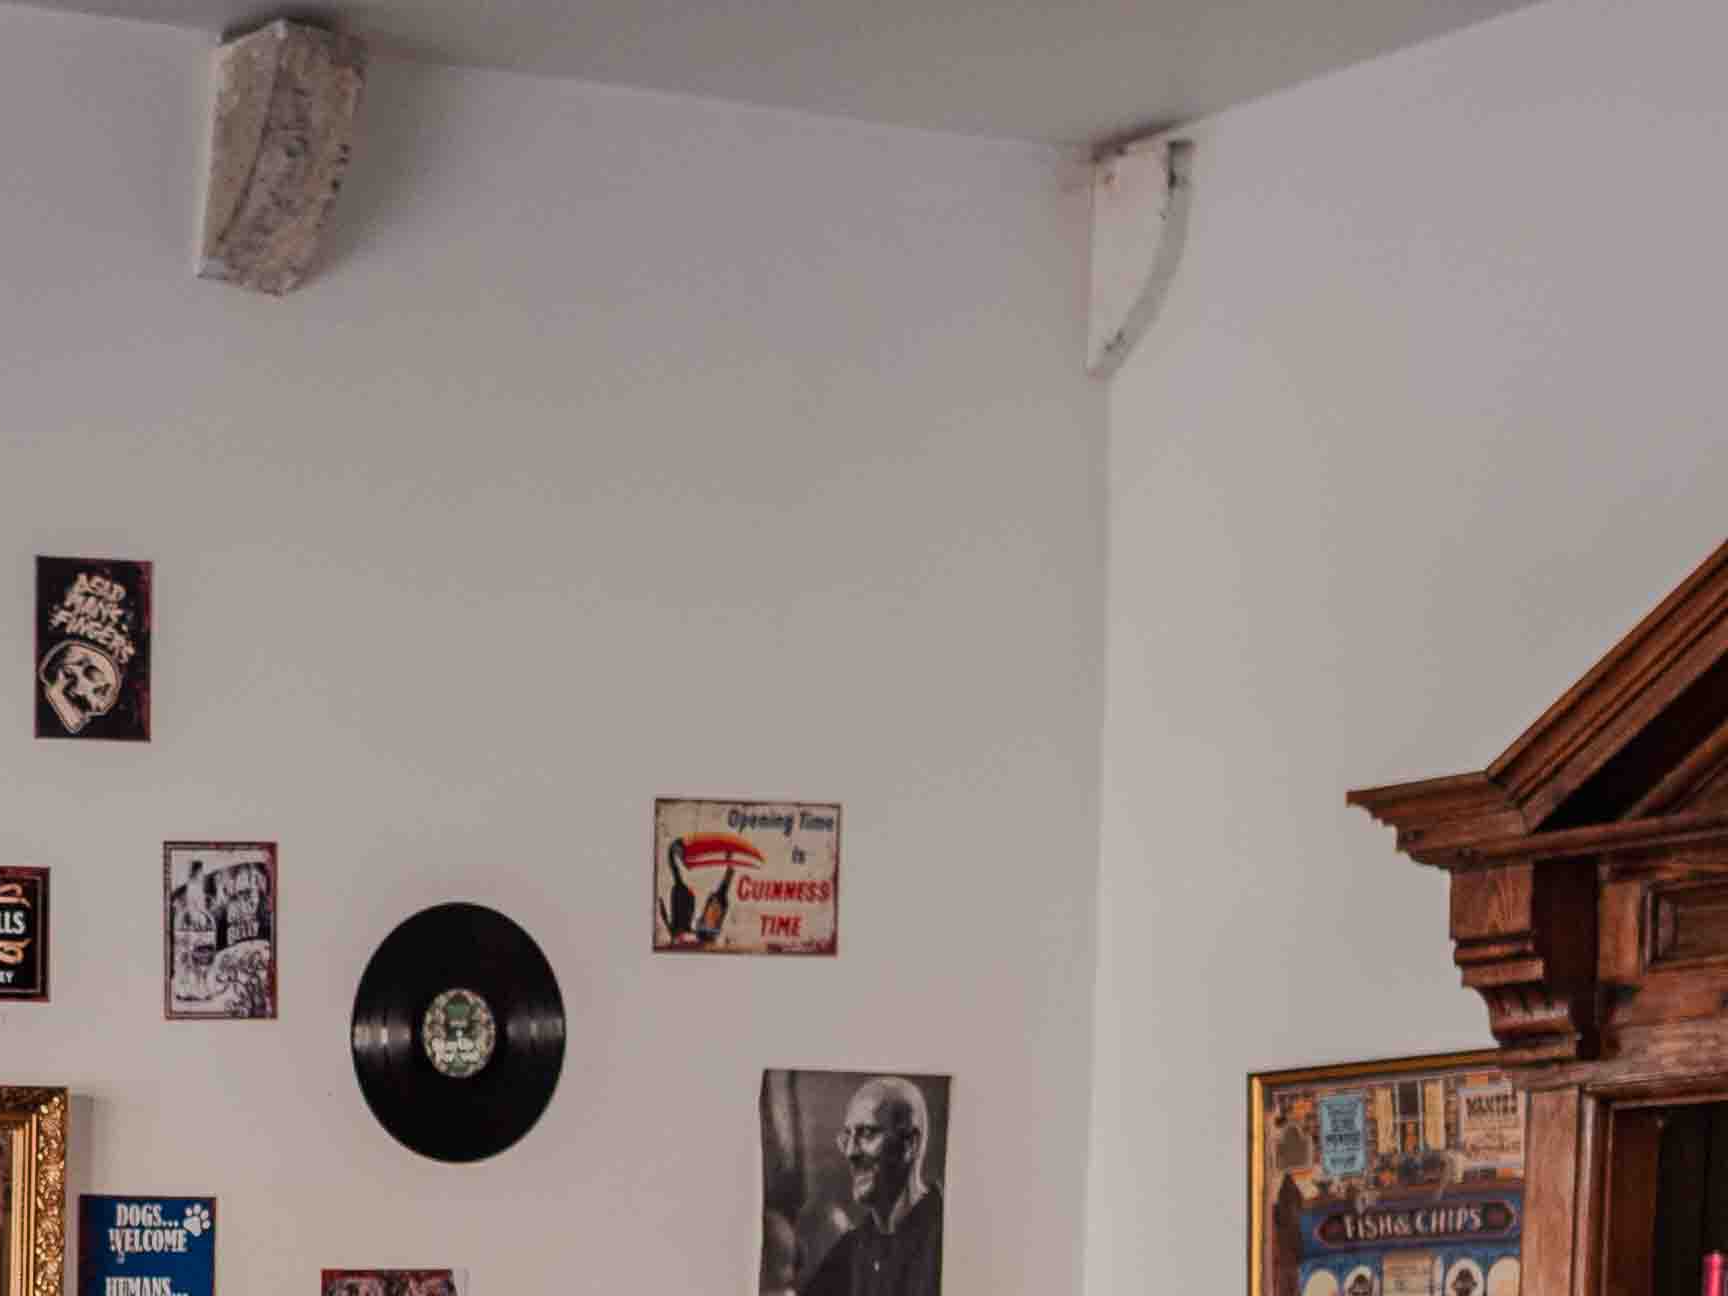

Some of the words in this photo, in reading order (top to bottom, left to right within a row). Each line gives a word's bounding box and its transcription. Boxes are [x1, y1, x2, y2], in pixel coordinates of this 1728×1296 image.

[736, 874, 832, 903] GUINNESS
[760, 914, 803, 937] TIME
[1345, 1214, 1393, 1241] FISH
[1414, 1206, 1482, 1233] CHIPS
[108, 1228, 188, 1253] WELCOME
